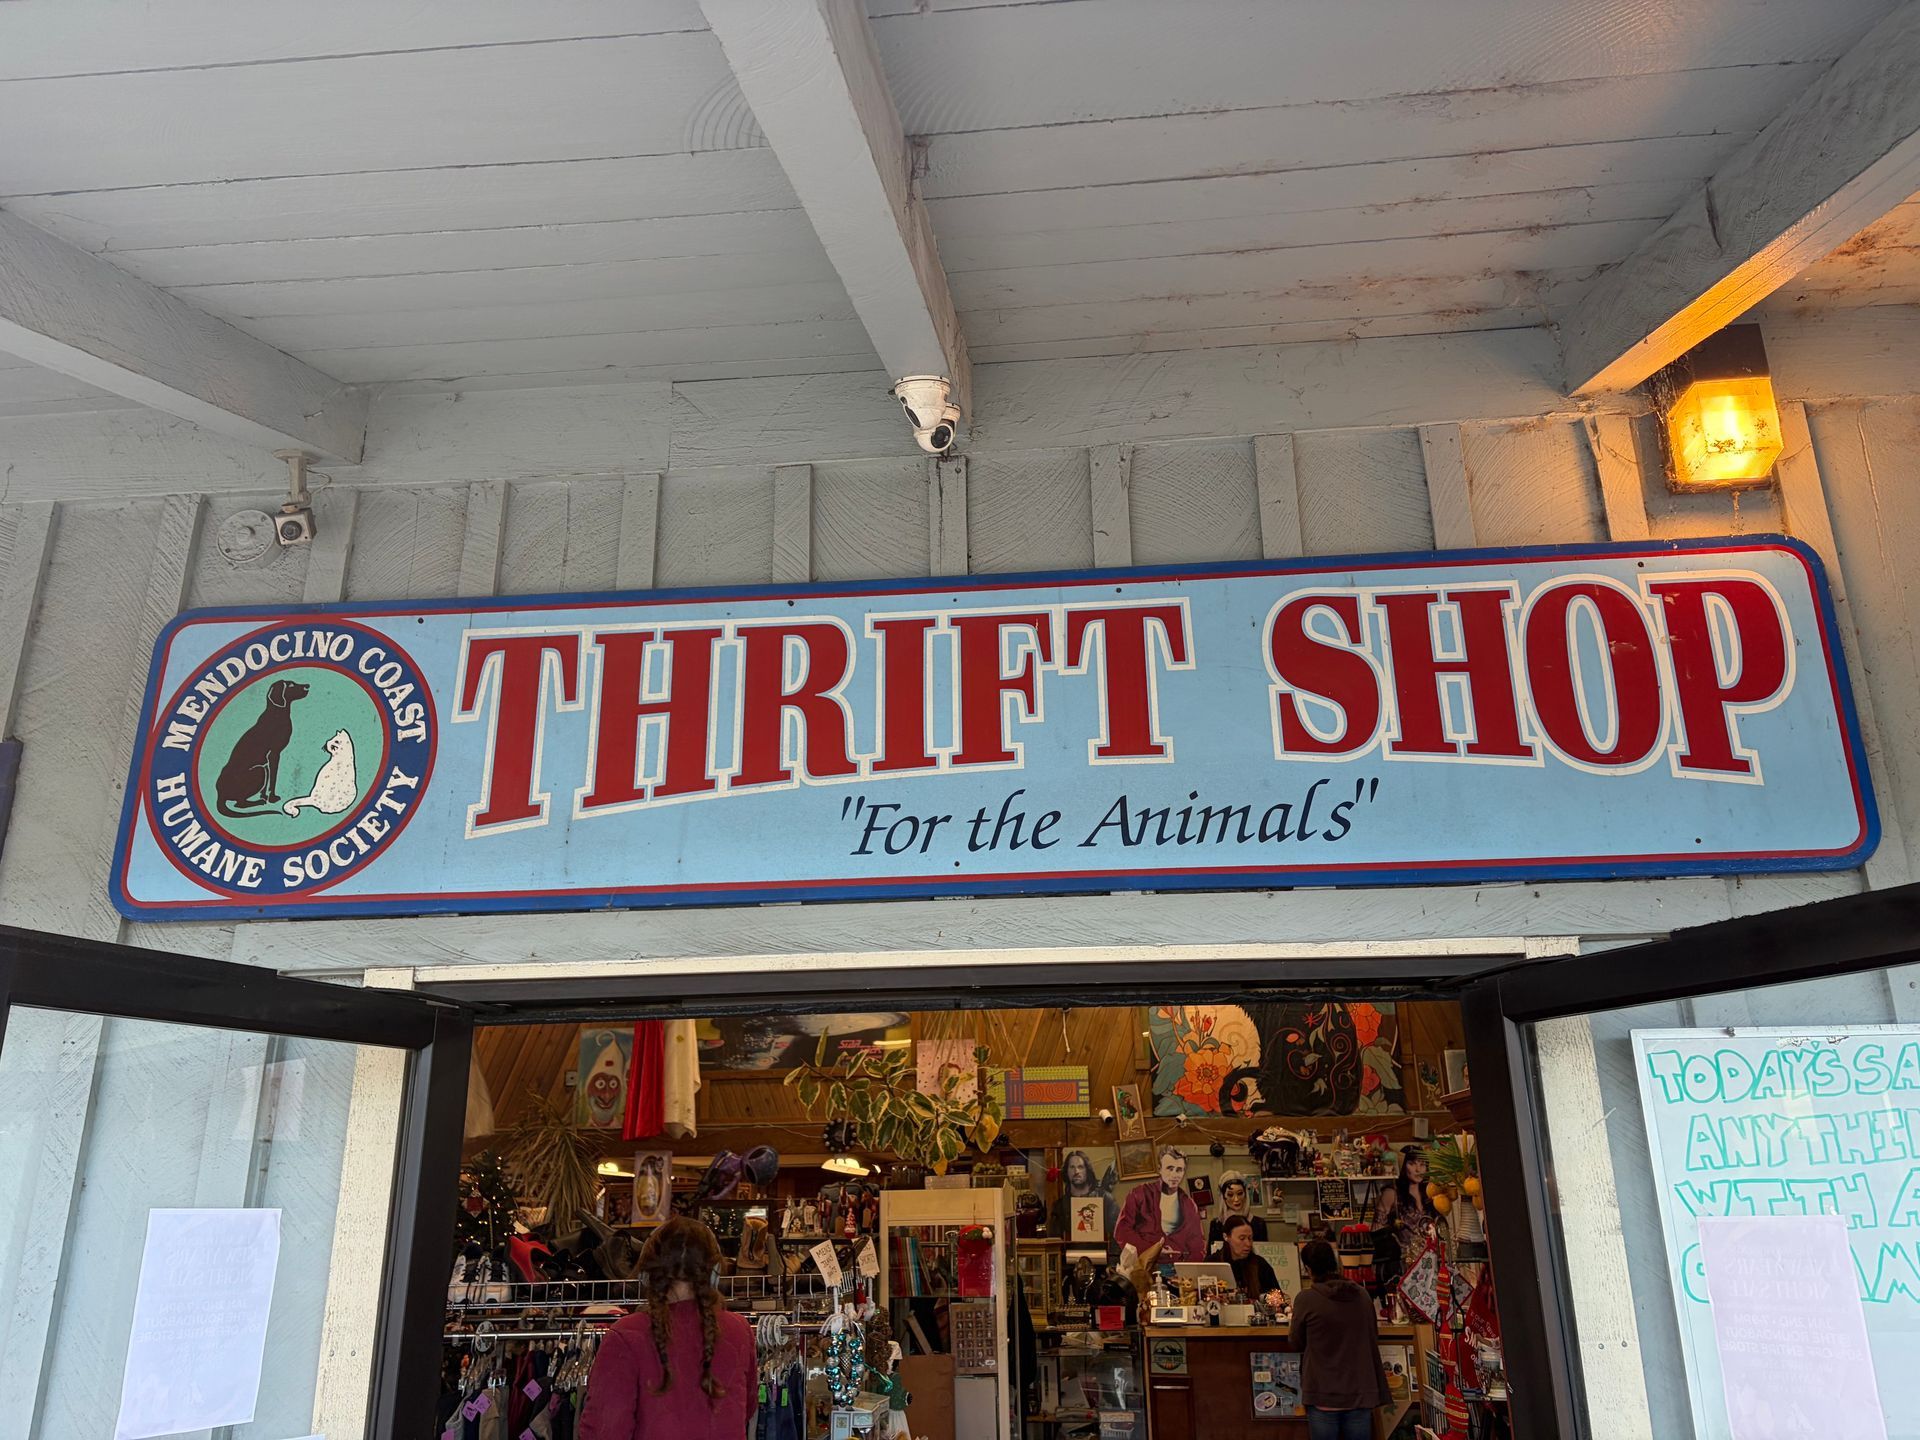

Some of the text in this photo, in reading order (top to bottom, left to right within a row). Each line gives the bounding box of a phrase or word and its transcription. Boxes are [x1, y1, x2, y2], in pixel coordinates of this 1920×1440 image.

[162, 630, 426, 752] MENDOCINO COAST
[452, 569, 1796, 838] THRIFT SHOP
[157, 766, 419, 888] HUMANE SOCIETY
[967, 789, 1061, 850] the
[1648, 1041, 1851, 1103] TODAY'S
